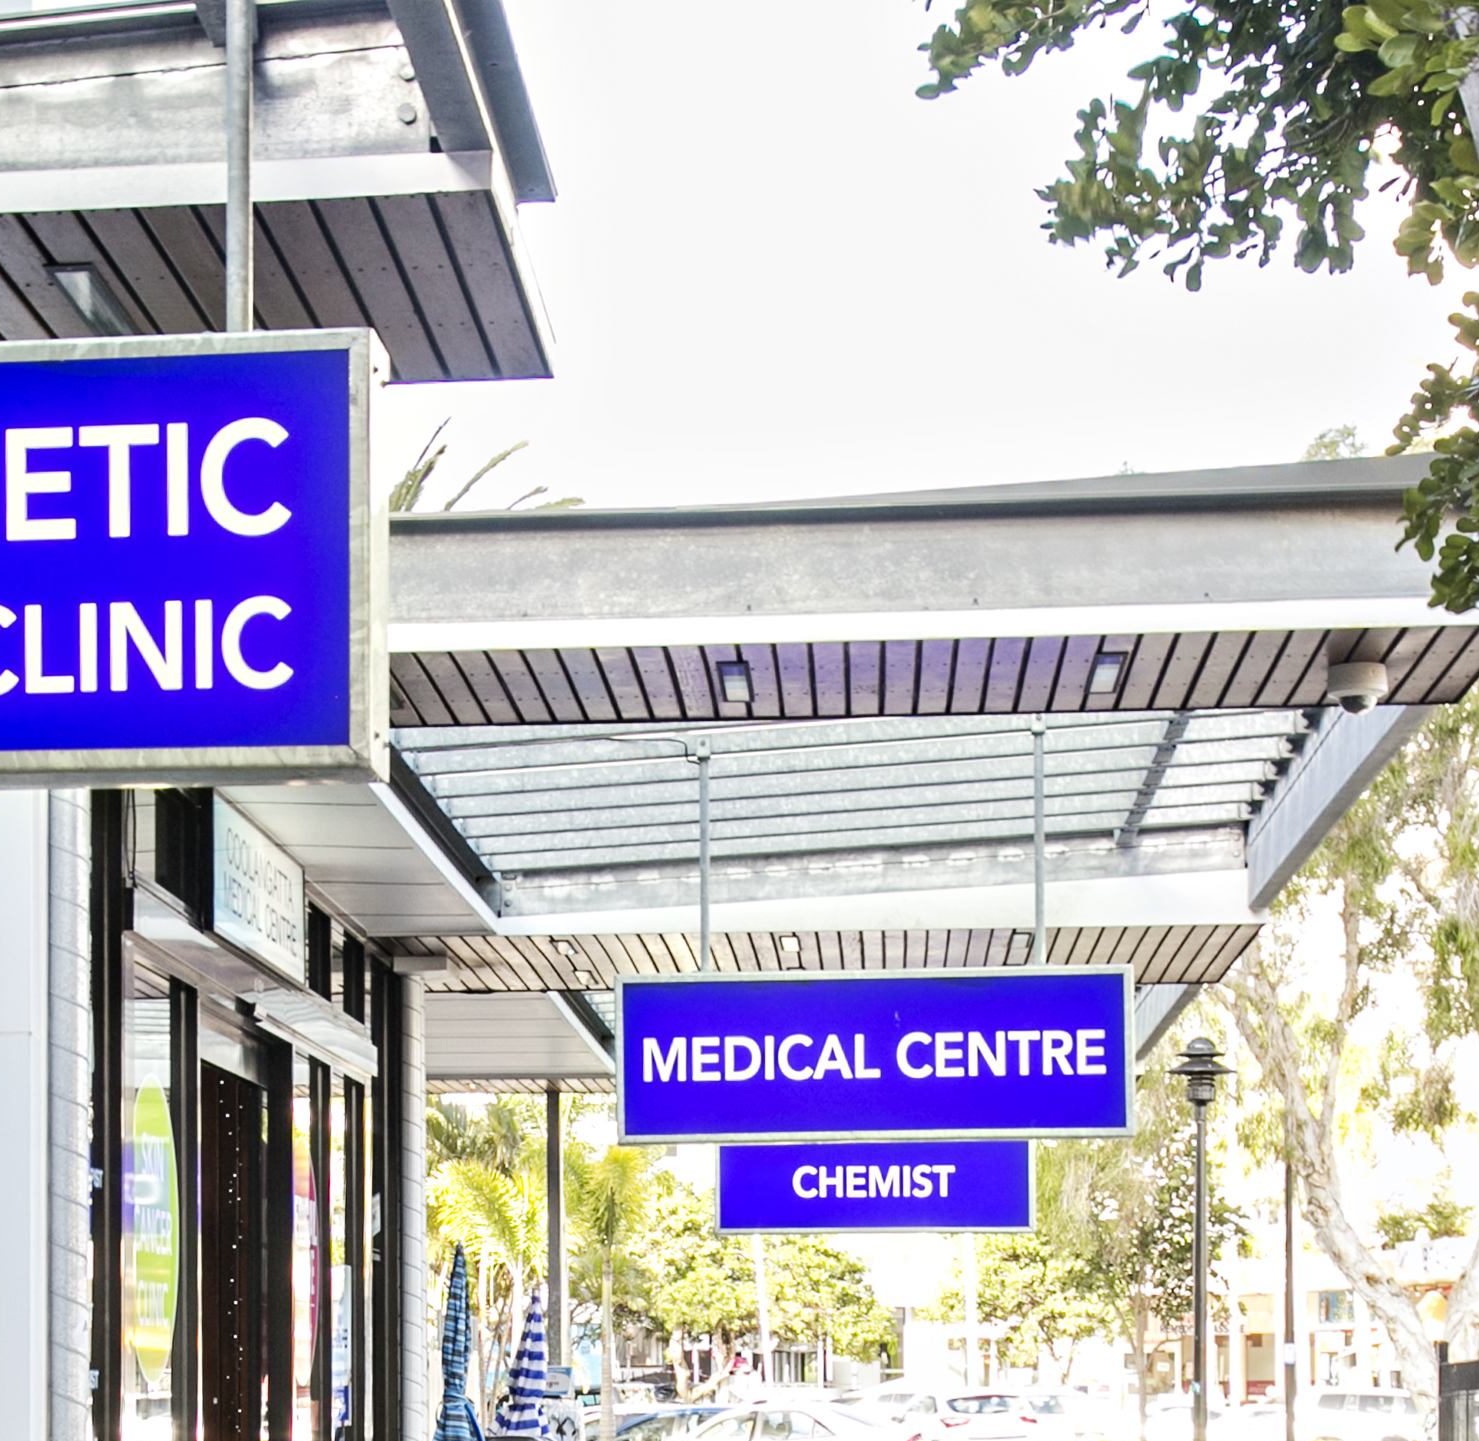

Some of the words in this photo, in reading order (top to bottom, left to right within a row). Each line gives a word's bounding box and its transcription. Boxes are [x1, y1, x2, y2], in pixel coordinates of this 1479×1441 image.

[226, 827, 294, 913] COOLANGATTA
[223, 871, 262, 932] MEDICAL
[265, 903, 297, 958] CENTRE
[641, 1033, 881, 1083] MEDICAL
[896, 1028, 1108, 1079] CENTRE
[141, 1132, 164, 1182] SKIN
[792, 1163, 957, 1199] CHEMIST
[134, 1205, 172, 1256] CANCER
[138, 1280, 169, 1327] CLINIC
